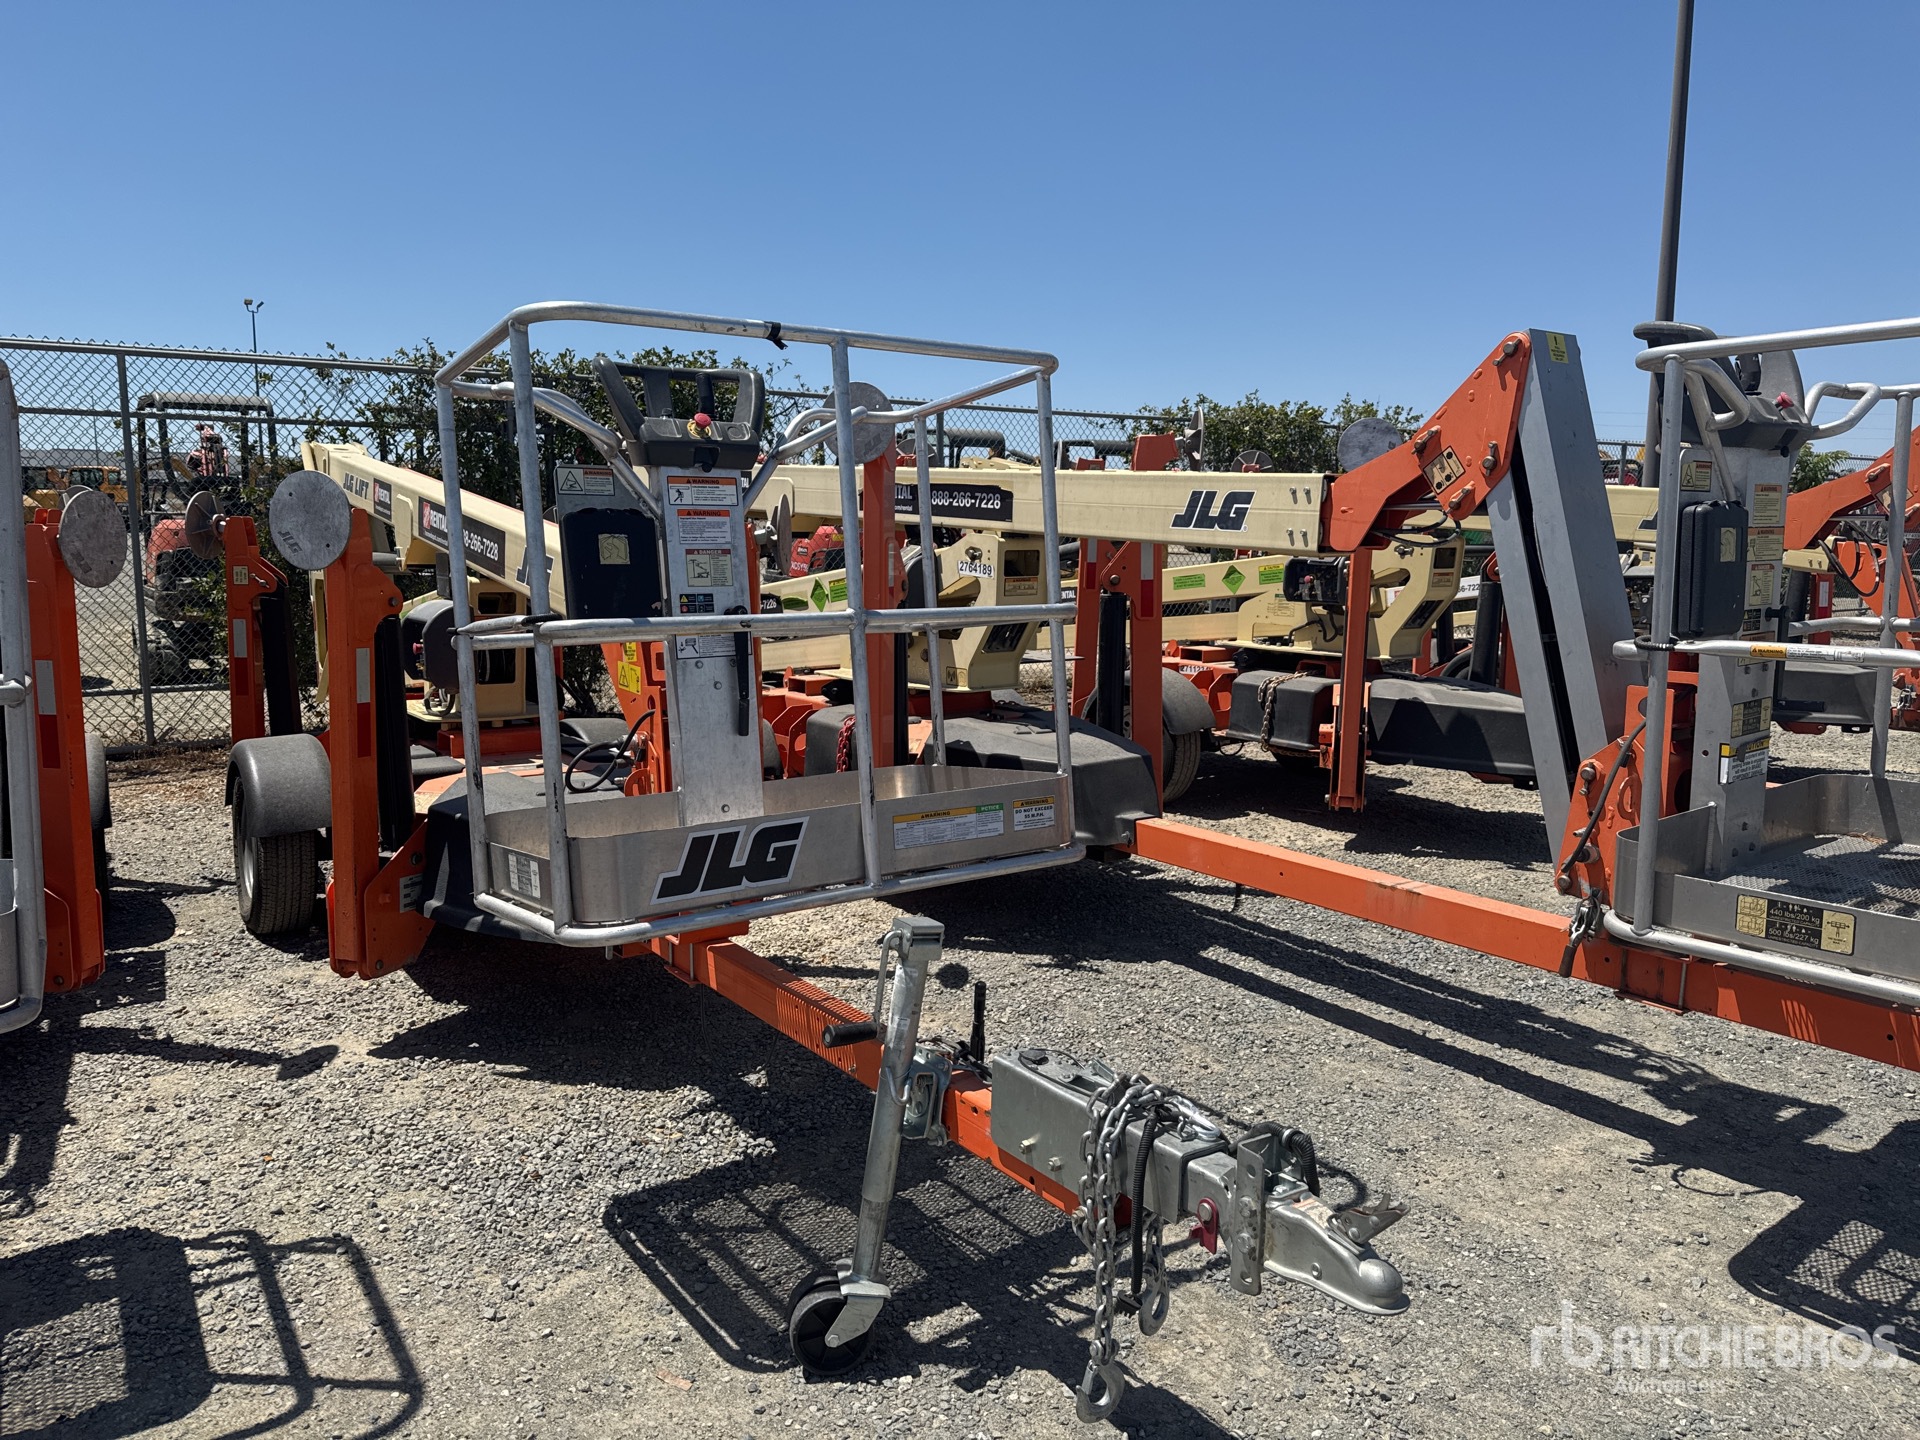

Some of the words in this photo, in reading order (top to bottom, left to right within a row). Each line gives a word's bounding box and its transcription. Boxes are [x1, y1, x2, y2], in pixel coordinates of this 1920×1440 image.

[355, 476, 370, 499] LIFT
[741, 477, 749, 488] TAL
[931, 490, 1001, 509] 888-266-7228
[1170, 489, 1257, 531] JLG
[277, 530, 303, 555] JLG
[462, 529, 499, 561] 8-266-7228
[959, 560, 993, 576] 2764189
[1061, 589, 1076, 600] NTAL
[1025, 798, 1049, 806] WARNING
[924, 811, 951, 819] WARNING
[654, 819, 807, 902] JLG
[1769, 908, 1783, 916] 440
[1784, 910, 1810, 920] lbs/200
[1811, 915, 1820, 924] kg
[1768, 927, 1782, 936] 500
[1783, 929, 1809, 941] lbs/227
[1810, 935, 1819, 944] kg
